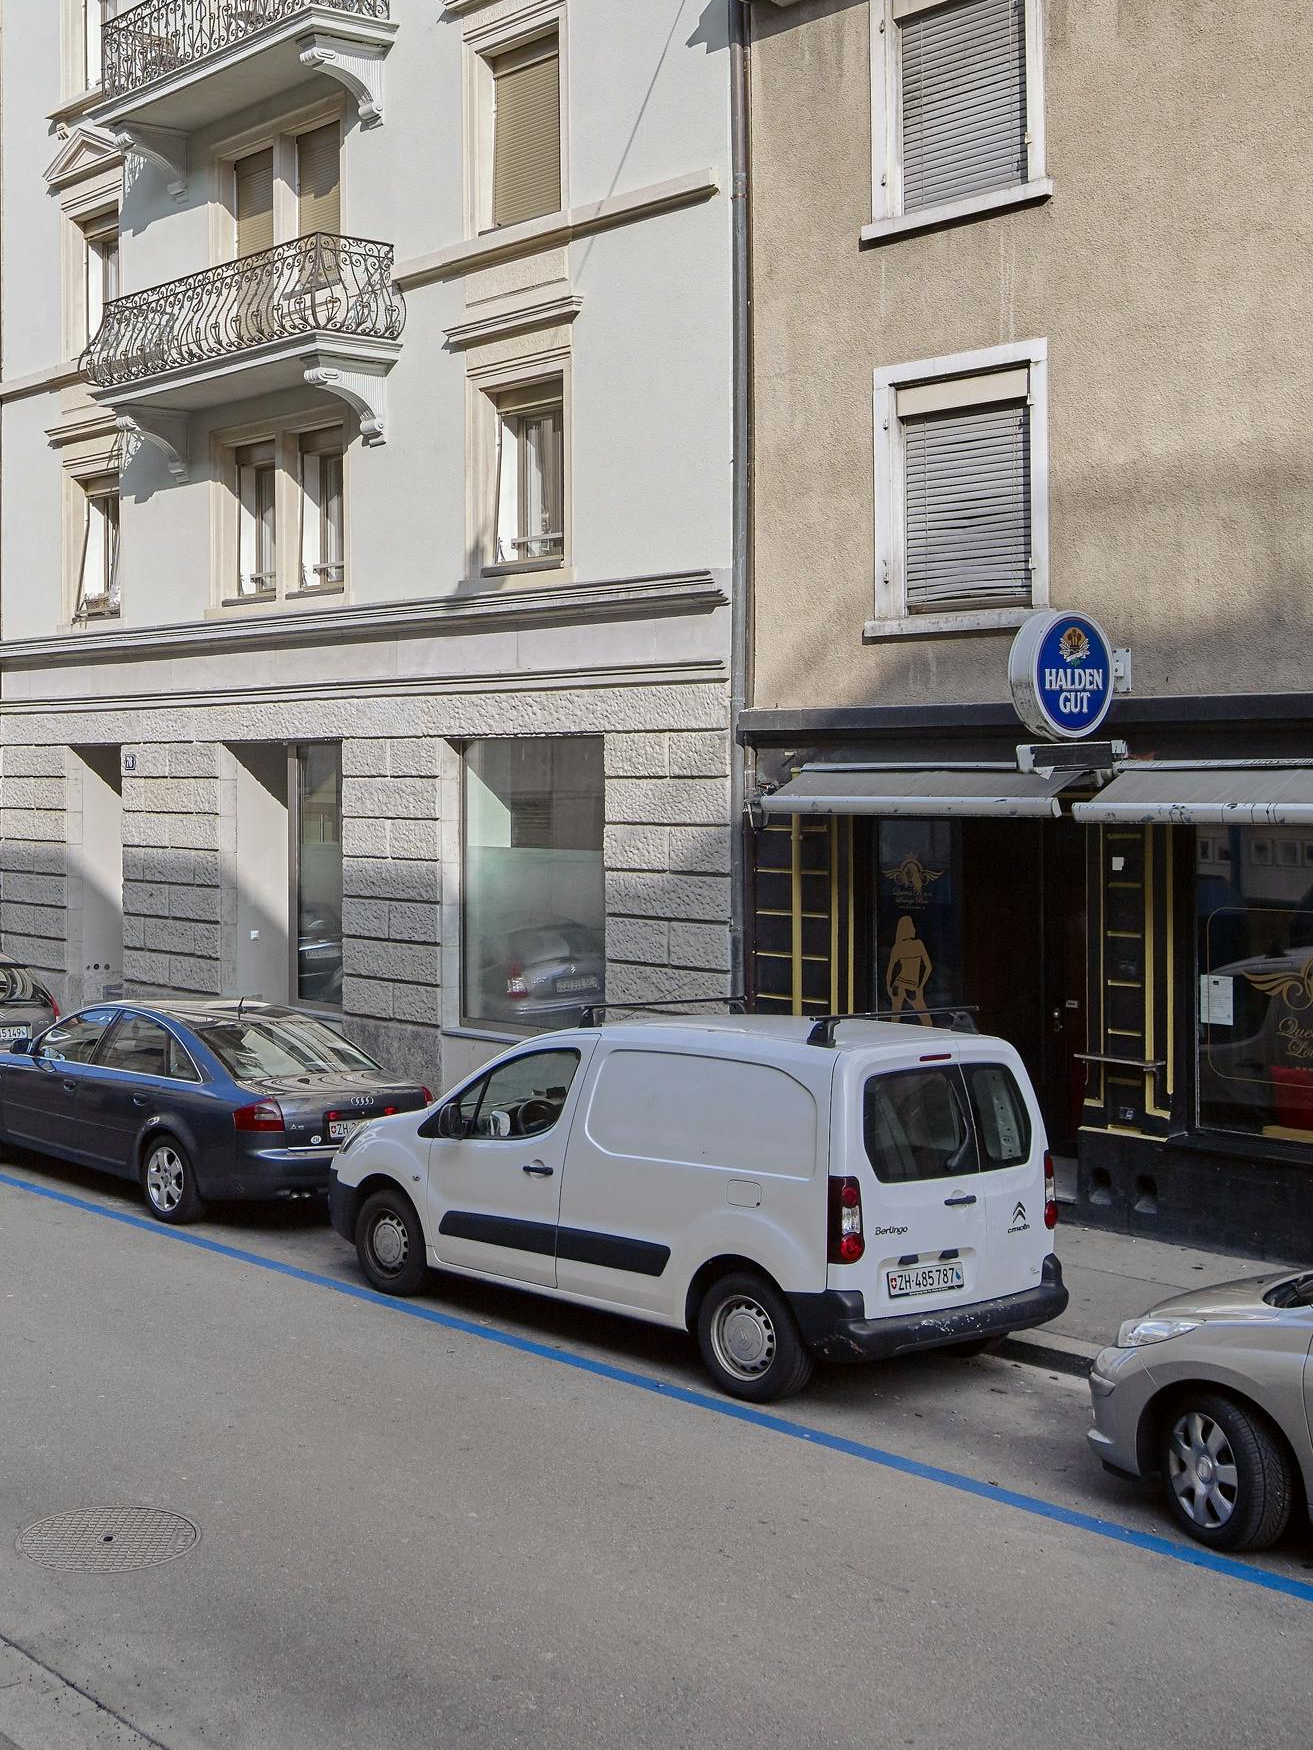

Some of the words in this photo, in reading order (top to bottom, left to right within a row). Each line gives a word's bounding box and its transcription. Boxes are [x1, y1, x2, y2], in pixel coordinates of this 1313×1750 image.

[1044, 668, 1103, 690] HALDEN
[1059, 691, 1091, 714] GUT
[1276, 1016, 1313, 1039] Que
[875, 1225, 908, 1236] Berlingo
